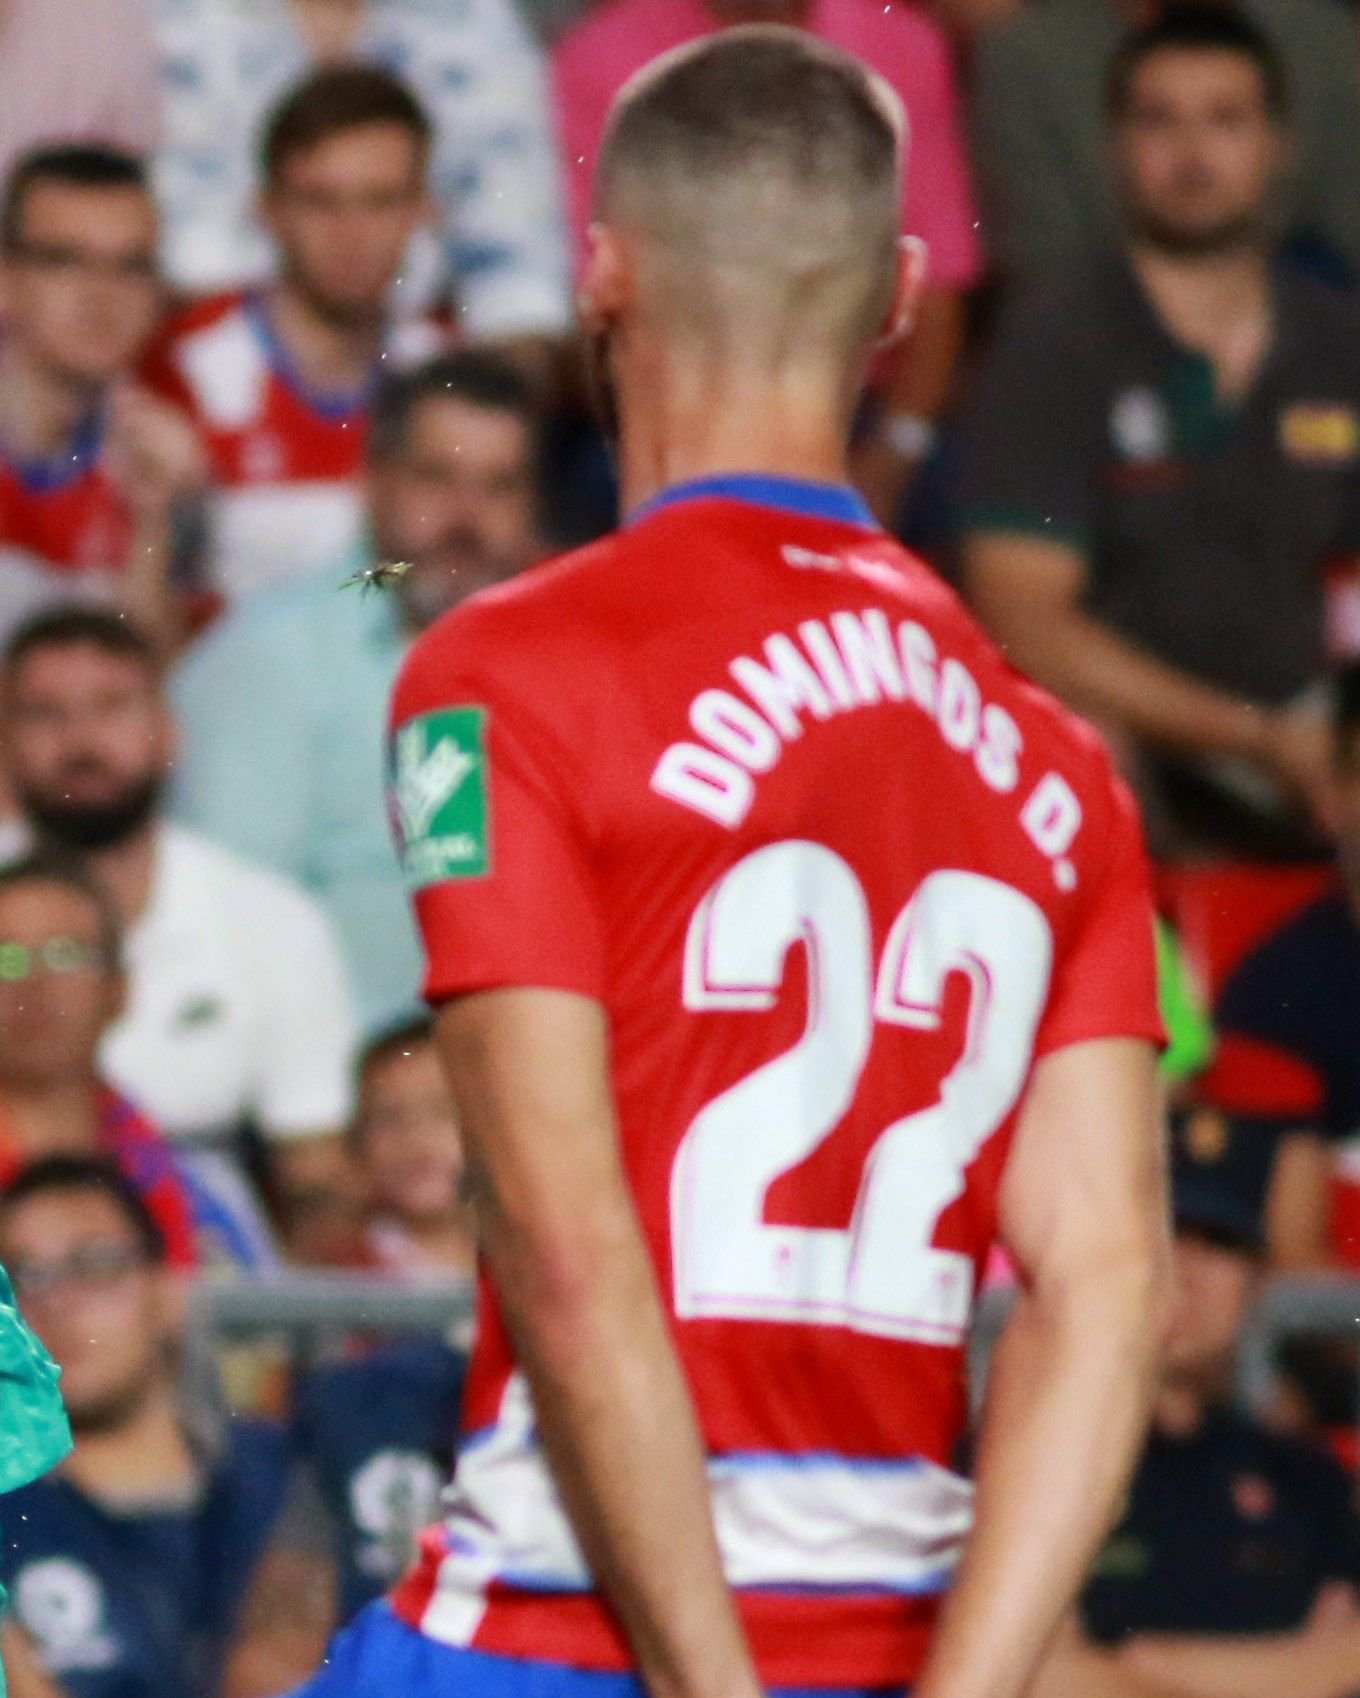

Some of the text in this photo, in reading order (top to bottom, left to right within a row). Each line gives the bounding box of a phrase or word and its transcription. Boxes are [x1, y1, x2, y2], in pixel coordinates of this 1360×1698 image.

[649, 608, 1083, 892] DOMINGOS D.
[669, 838, 1056, 1348] 22
